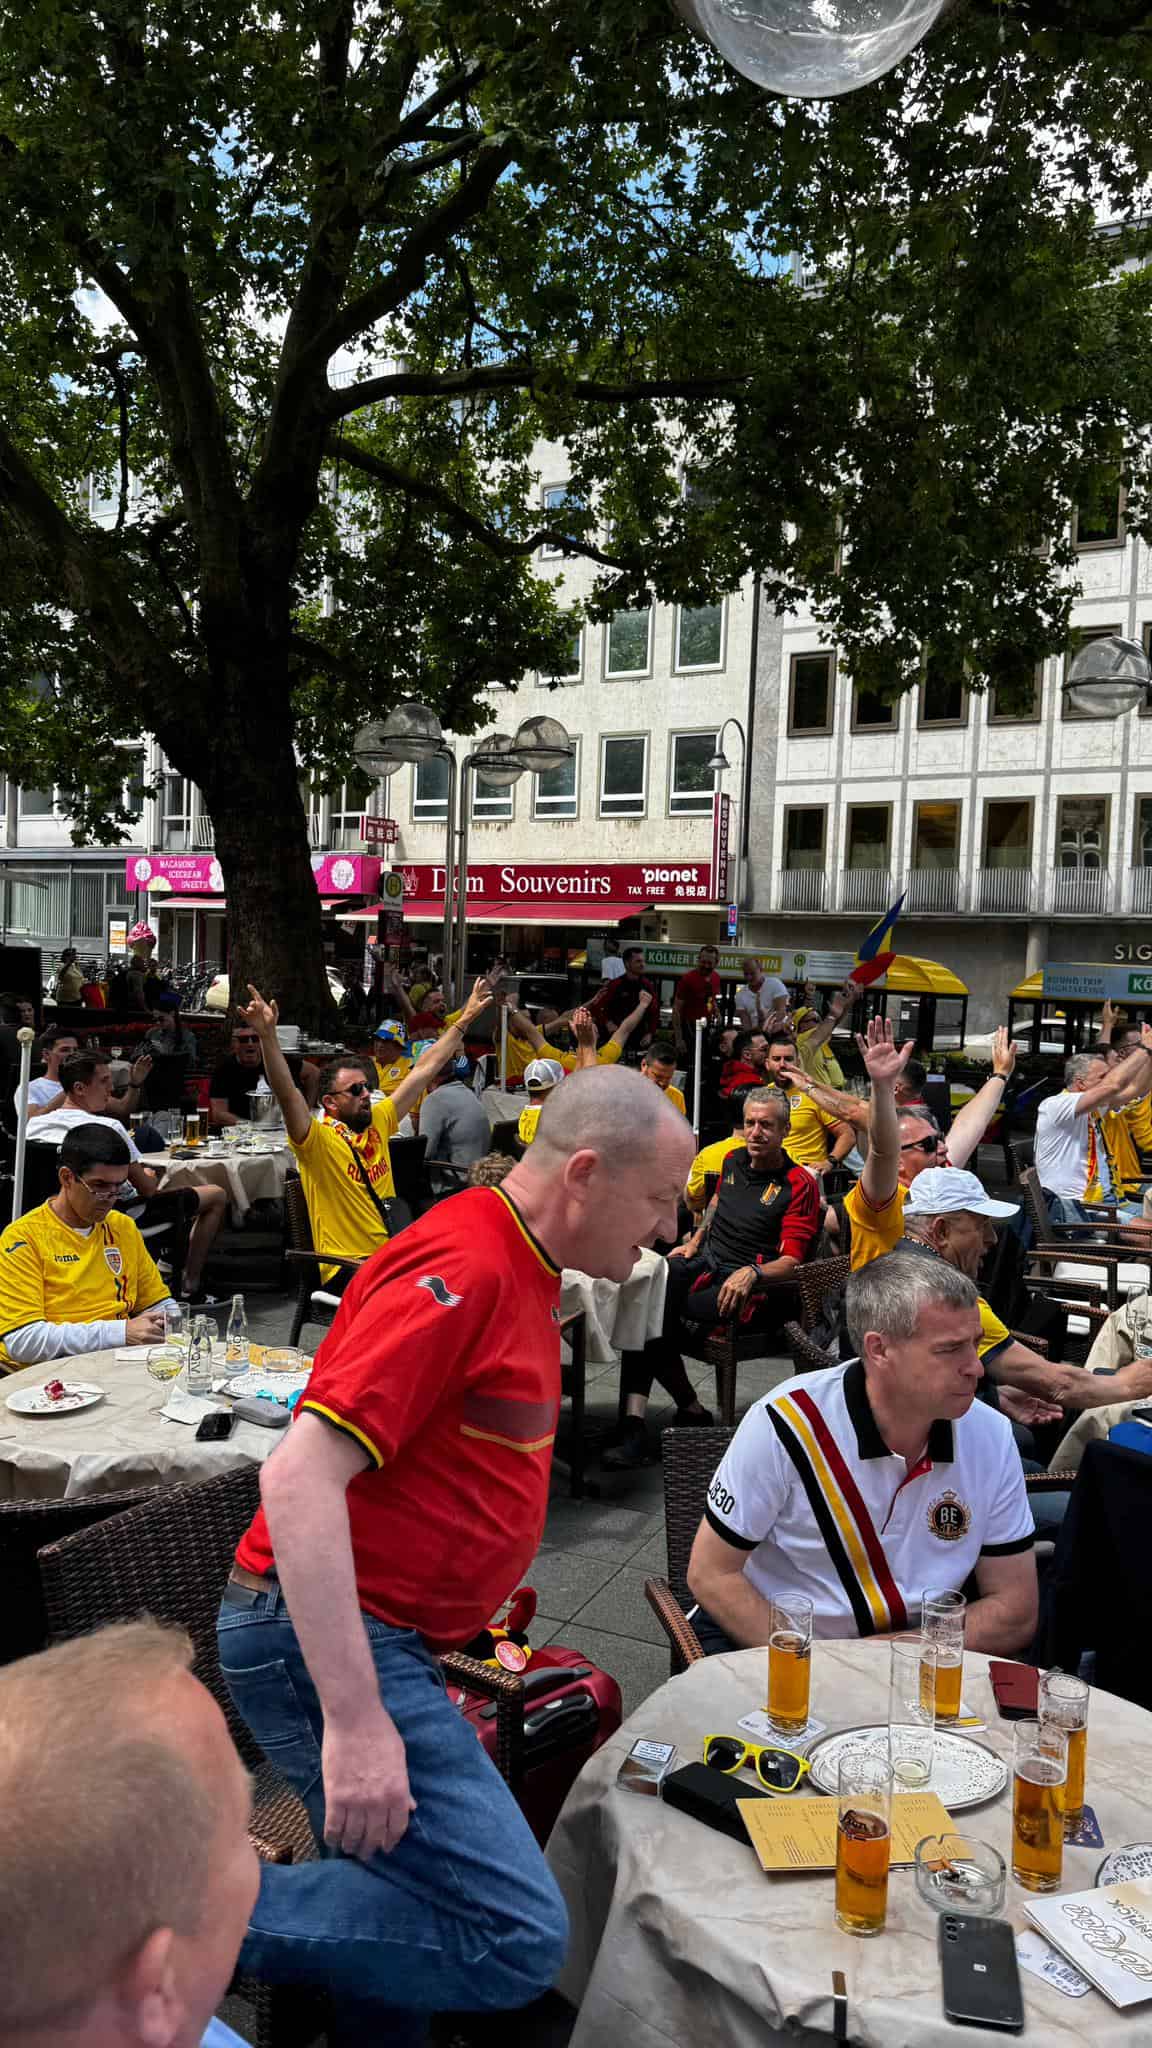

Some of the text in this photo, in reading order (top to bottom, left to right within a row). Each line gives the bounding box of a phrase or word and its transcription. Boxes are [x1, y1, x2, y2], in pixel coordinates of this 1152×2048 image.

[500, 866, 612, 894] Souvenirs
[642, 868, 699, 883] planet
[628, 886, 666, 895] TAX FREE
[648, 951, 690, 965] KÖLNER
[940, 1506, 958, 1525] BE
